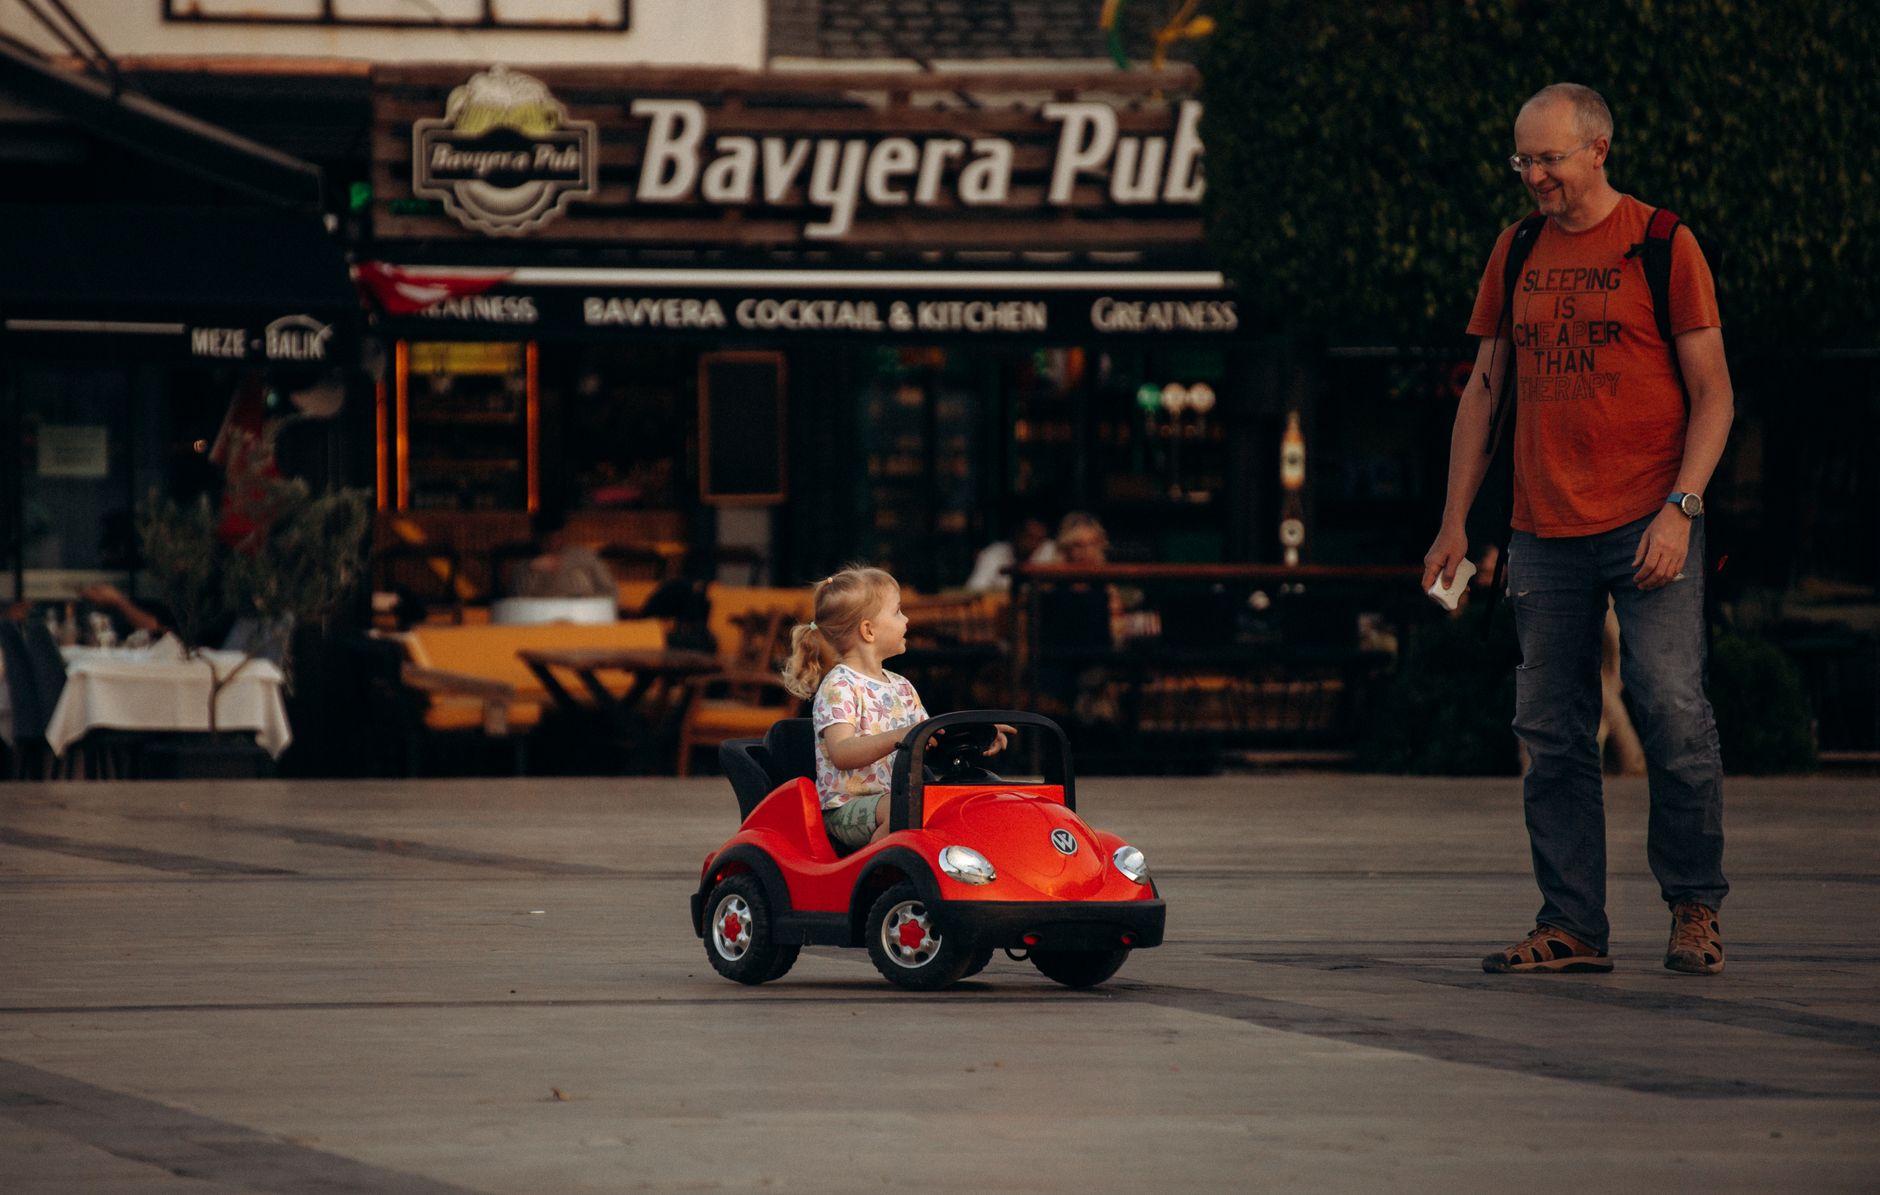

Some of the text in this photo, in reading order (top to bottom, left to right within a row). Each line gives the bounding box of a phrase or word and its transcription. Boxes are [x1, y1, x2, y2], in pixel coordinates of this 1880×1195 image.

[431, 142, 580, 176] Bavyera Pub
[630, 98, 1014, 240] Bavyera
[1523, 267, 1622, 292] SLEEPING
[583, 297, 1048, 331] BAVYERA COCKTAIL & KITCHEN
[1553, 296, 1577, 319] IS
[191, 328, 246, 358] MEZE
[1514, 320, 1622, 347] CHEAPER
[1534, 349, 1595, 375] THAN
[1520, 373, 1622, 401] THERAPY
